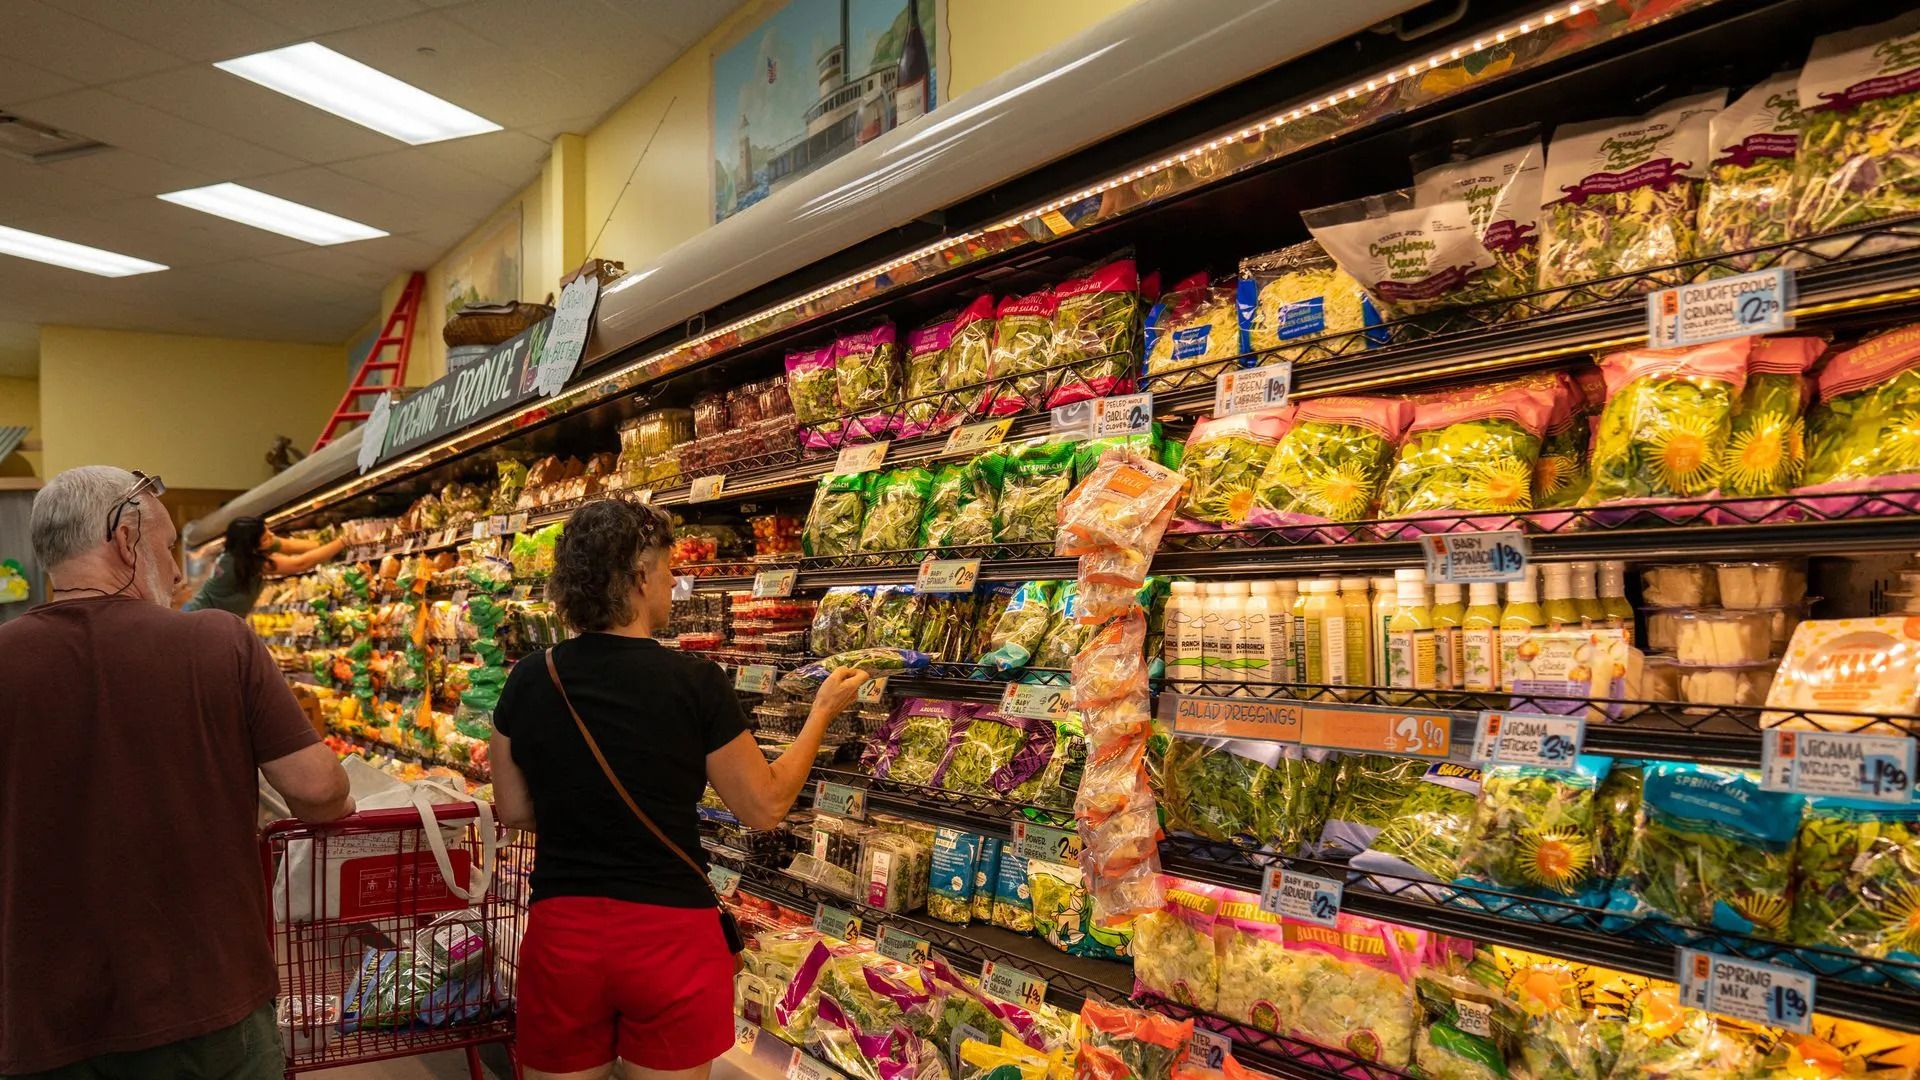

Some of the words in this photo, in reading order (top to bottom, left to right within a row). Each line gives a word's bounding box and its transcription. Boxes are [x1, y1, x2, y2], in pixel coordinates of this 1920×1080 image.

[1684, 302, 1734, 321] CRUNCH
[445, 338, 525, 427] PRODUCE
[1236, 380, 1262, 394] GREEN
[1452, 537, 1482, 550] BABY
[1181, 640, 1200, 649] RANCH
[1040, 693, 1069, 714] $2.49
[1179, 701, 1221, 720] SALAD
[1437, 762, 1472, 779] BABY
[1674, 775, 1720, 793] SPRING
[1724, 786, 1751, 804] MIX
[1025, 834, 1047, 846] POWER
[1024, 849, 1048, 860] GREENS
[1284, 874, 1301, 886] BABY
[1219, 901, 1253, 918] UTTER
[1296, 925, 1343, 948] BUTTER
[990, 972, 1013, 987] CAESAR
[1192, 1032, 1211, 1047] TTER
[1188, 1043, 1210, 1060] TTUCE
